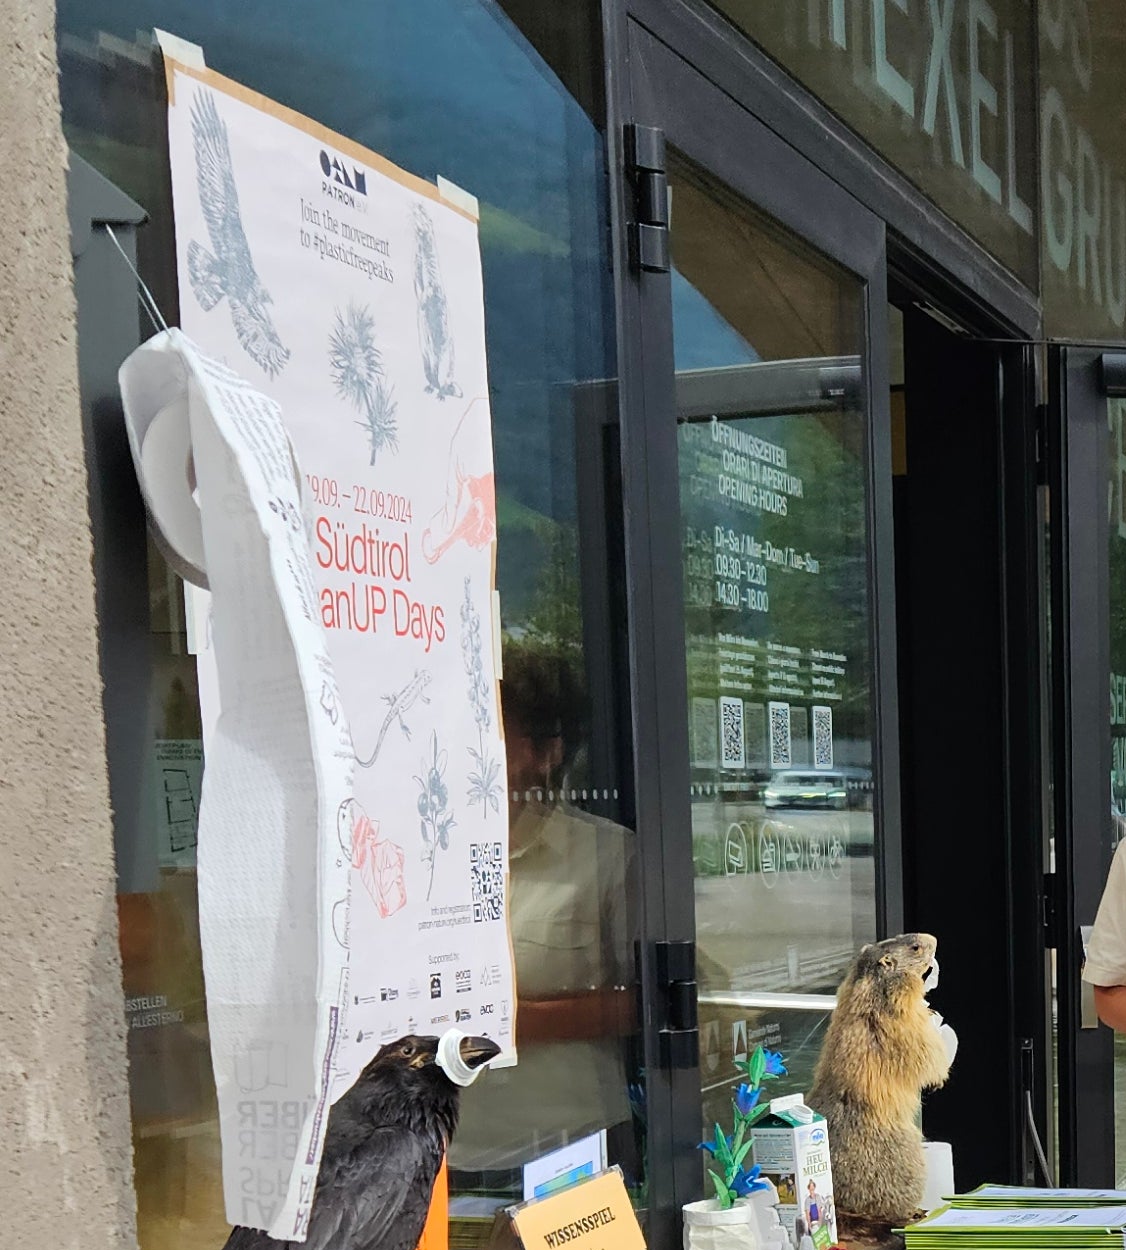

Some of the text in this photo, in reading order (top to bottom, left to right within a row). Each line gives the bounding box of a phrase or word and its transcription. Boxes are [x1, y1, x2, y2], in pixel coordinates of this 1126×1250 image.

[322, 181, 355, 208] PATRON
[300, 197, 391, 257] Join the movement
[299, 228, 394, 283] to #plasticfreepeaks
[718, 474, 788, 516] OPENING HOURS
[722, 449, 750, 479] ORARI
[762, 465, 804, 499] APERTURA
[353, 484, 413, 524] 22.09.2024
[316, 516, 412, 582] Südtirol
[316, 582, 446, 653] anUP Days
[802, 1161, 829, 1177] MILCH
[806, 1152, 823, 1167] HEU
[543, 1206, 616, 1250] WISSENSSPIEL
